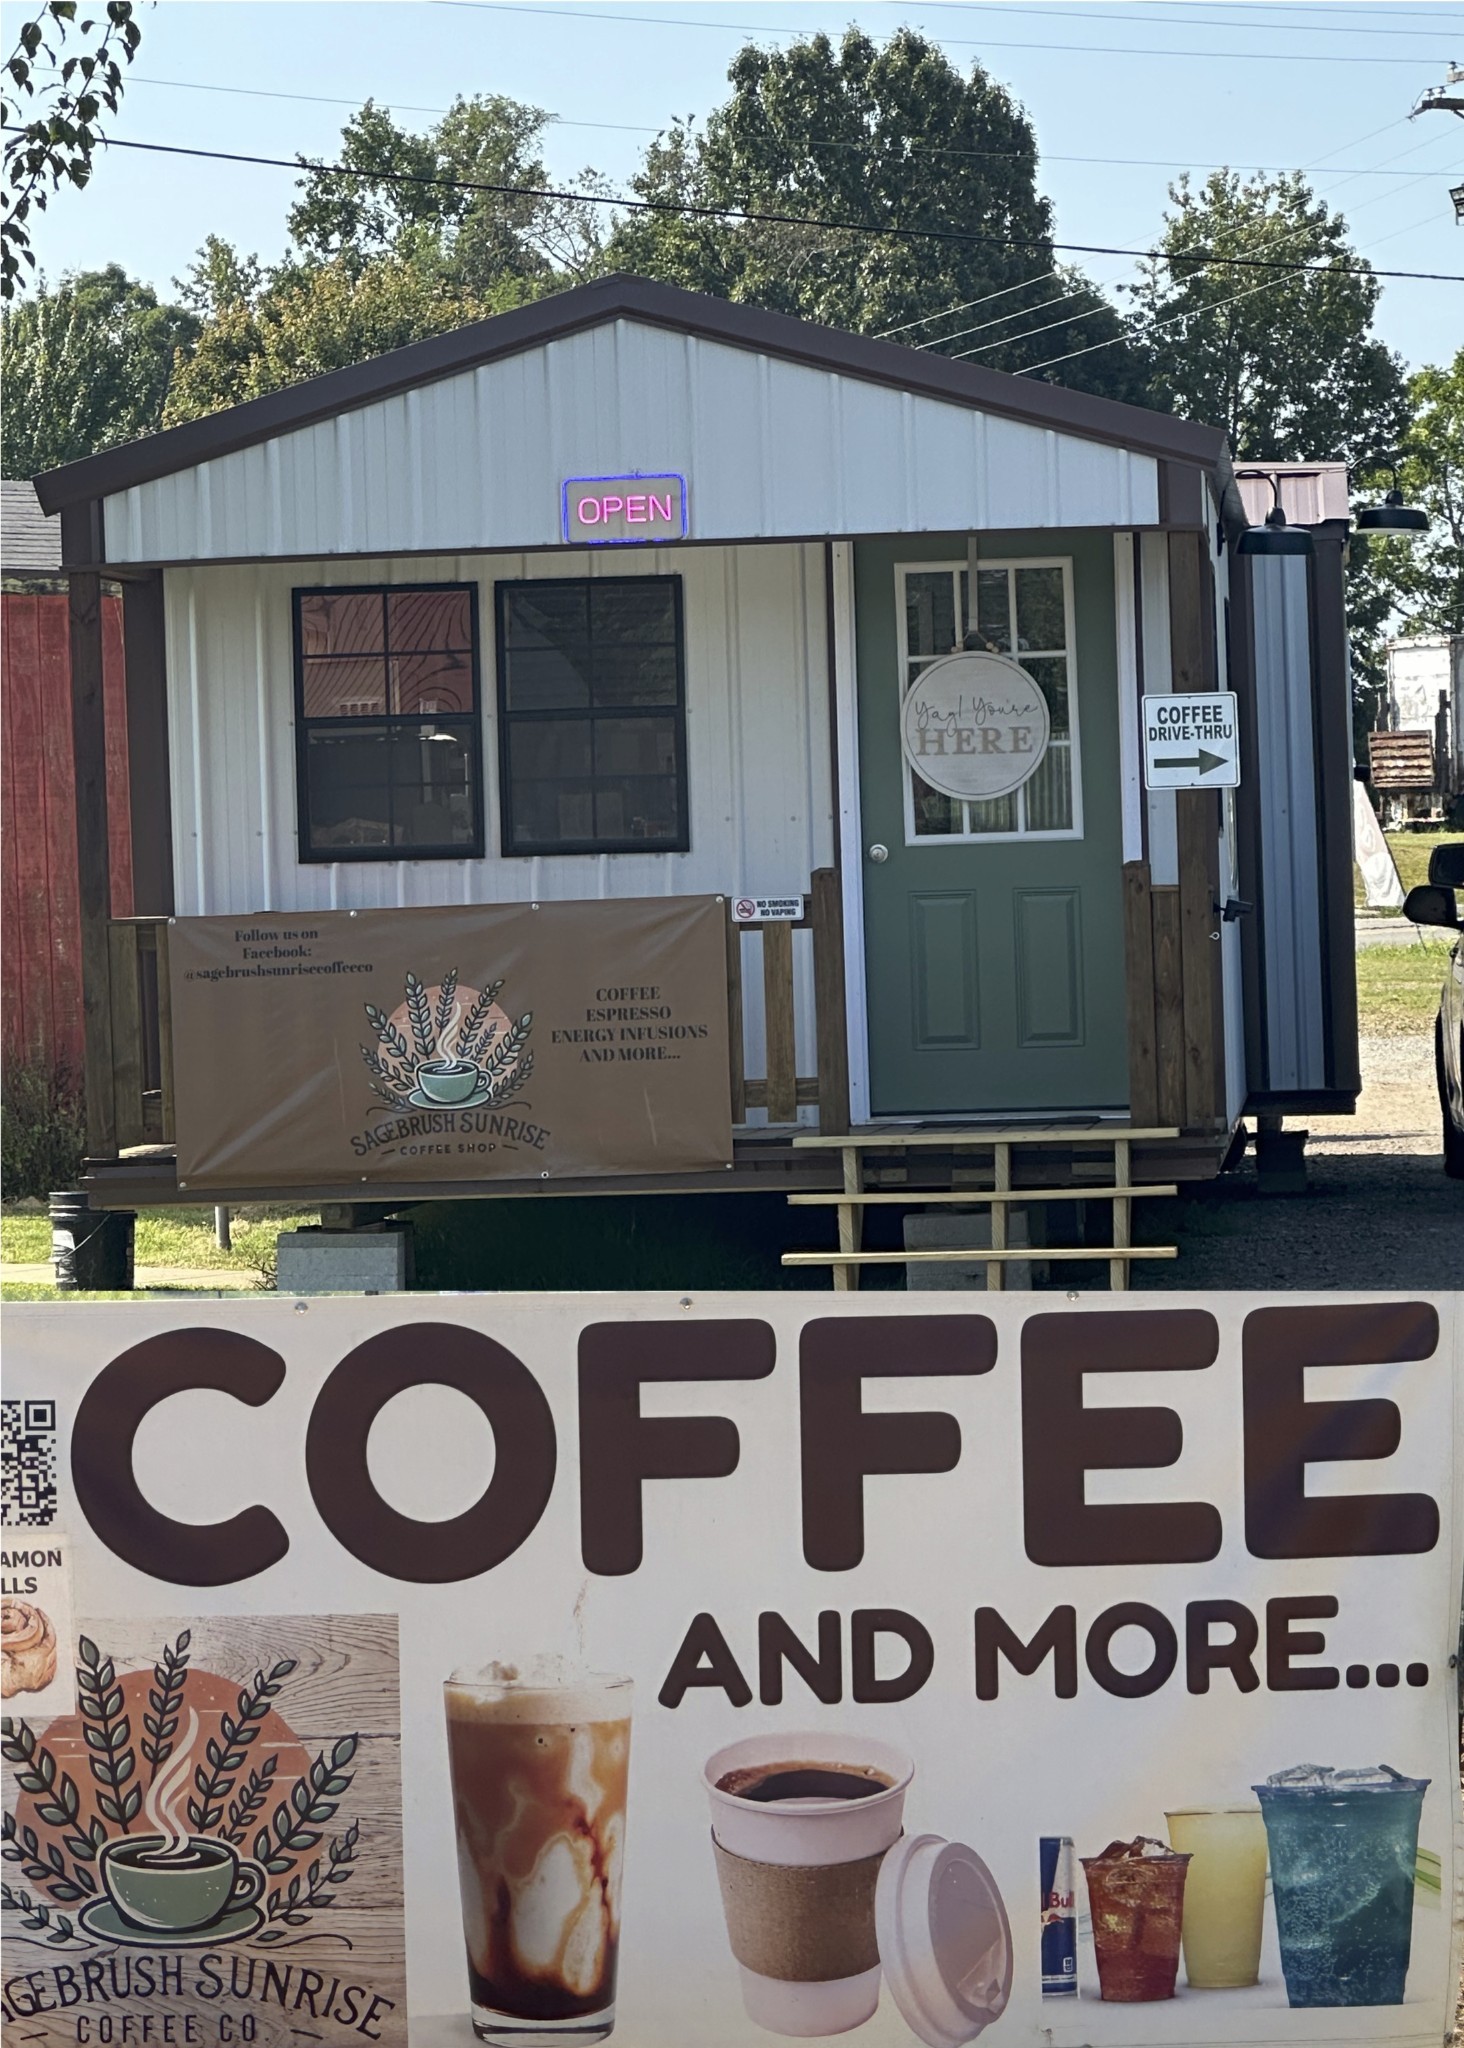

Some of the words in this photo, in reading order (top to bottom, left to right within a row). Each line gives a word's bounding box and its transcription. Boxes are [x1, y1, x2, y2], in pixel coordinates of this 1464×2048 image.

[578, 494, 672, 524] OPEN
[972, 696, 1039, 726] You're
[1157, 705, 1223, 725] COFFEE
[915, 726, 1033, 756] HERE
[1149, 724, 1233, 741] DRIVE-THRU
[757, 900, 767, 908] NO
[768, 899, 799, 908] SMOKING
[761, 908, 770, 916] NO
[771, 908, 796, 916] VAPING
[235, 929, 279, 942] Follow
[283, 930, 298, 940] us
[301, 929, 318, 940] on
[243, 945, 312, 959] Facebook:
[184, 961, 373, 982] @sagebrushsunrisecoffeeco
[596, 986, 660, 1001] COFFEE
[586, 1006, 671, 1022] ESPRESSO
[551, 1028, 616, 1044] ENERGY
[620, 1024, 708, 1041] INFUSIONS
[579, 1048, 615, 1063] AND
[618, 1046, 681, 1062] MORE...
[350, 1113, 456, 1156] SAGEBRUSH
[460, 1112, 551, 1150] SUNRISE
[400, 1144, 451, 1156] COFFEE
[458, 1142, 496, 1153] SHOP
[72, 1301, 1441, 1586] COFFEE
[1, 1550, 62, 1568] AMON
[658, 1607, 935, 1709] AND
[974, 1595, 1429, 1701] MORE...
[195, 1953, 395, 2041] SUNRISE
[77, 2014, 196, 2044] COFFEE
